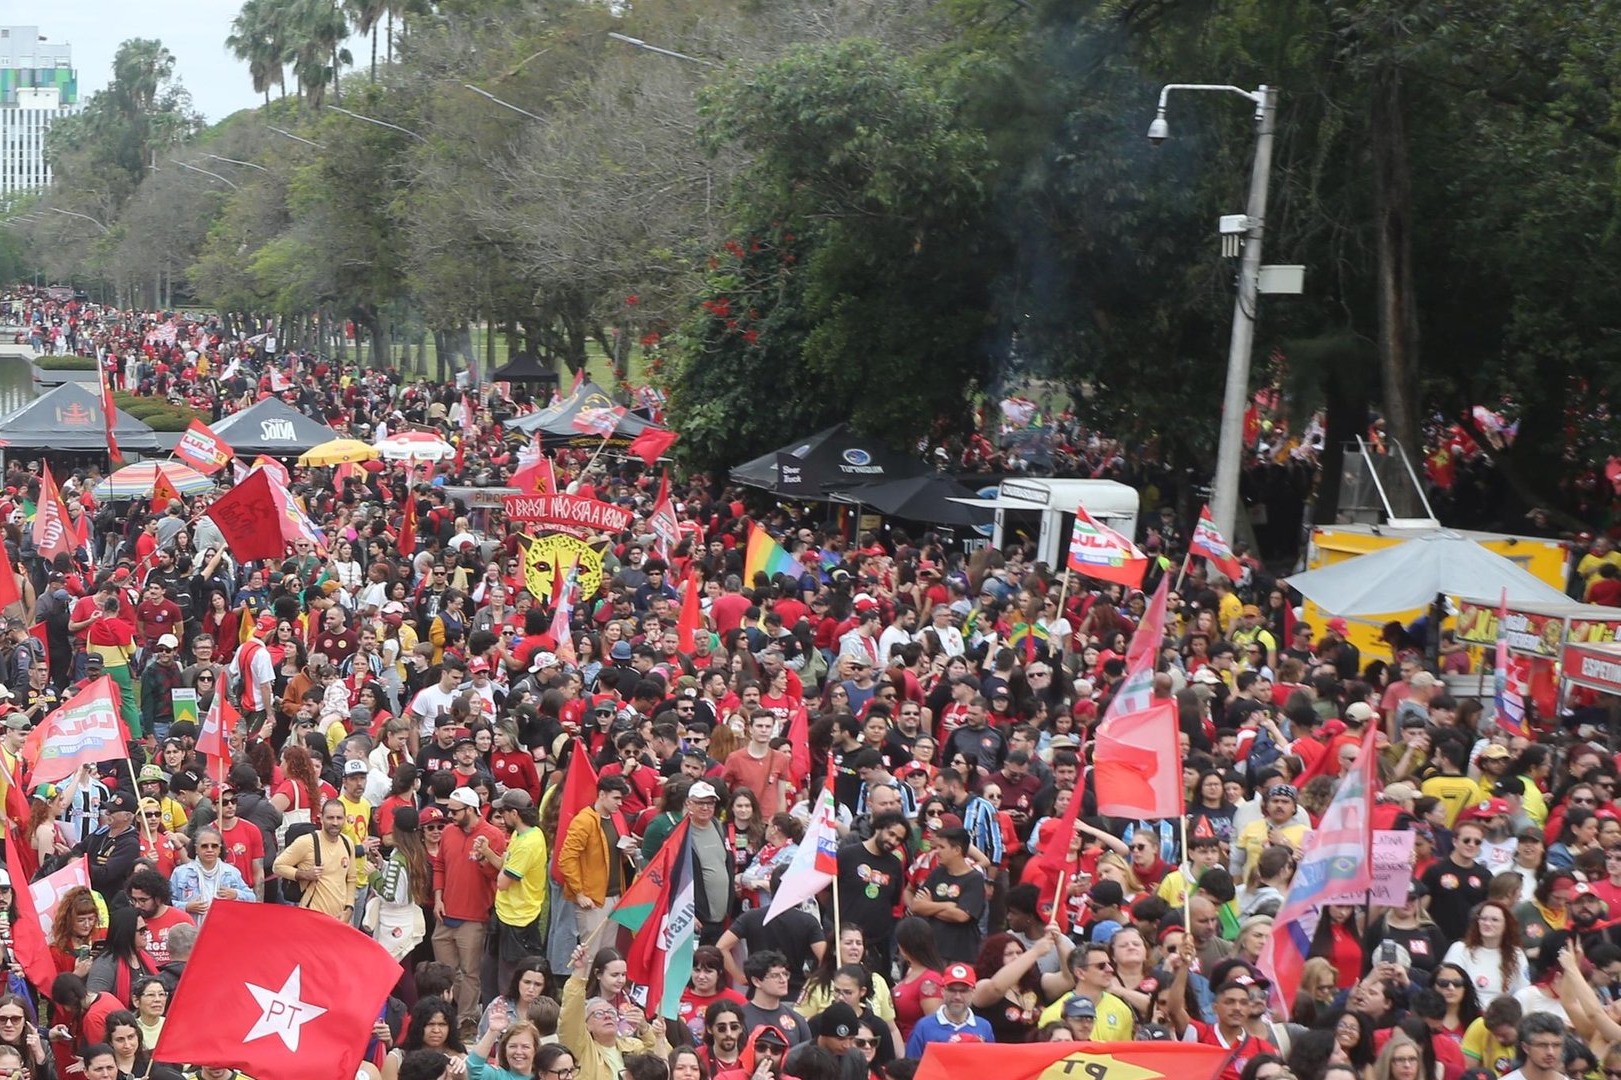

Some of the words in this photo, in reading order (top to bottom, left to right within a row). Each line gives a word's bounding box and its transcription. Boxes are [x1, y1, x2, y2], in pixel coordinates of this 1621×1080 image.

[183, 436, 215, 455] LULA
[505, 500, 514, 517] O
[515, 498, 548, 518] BRASIL
[550, 495, 571, 519] NÃO
[266, 999, 302, 1029] PT
